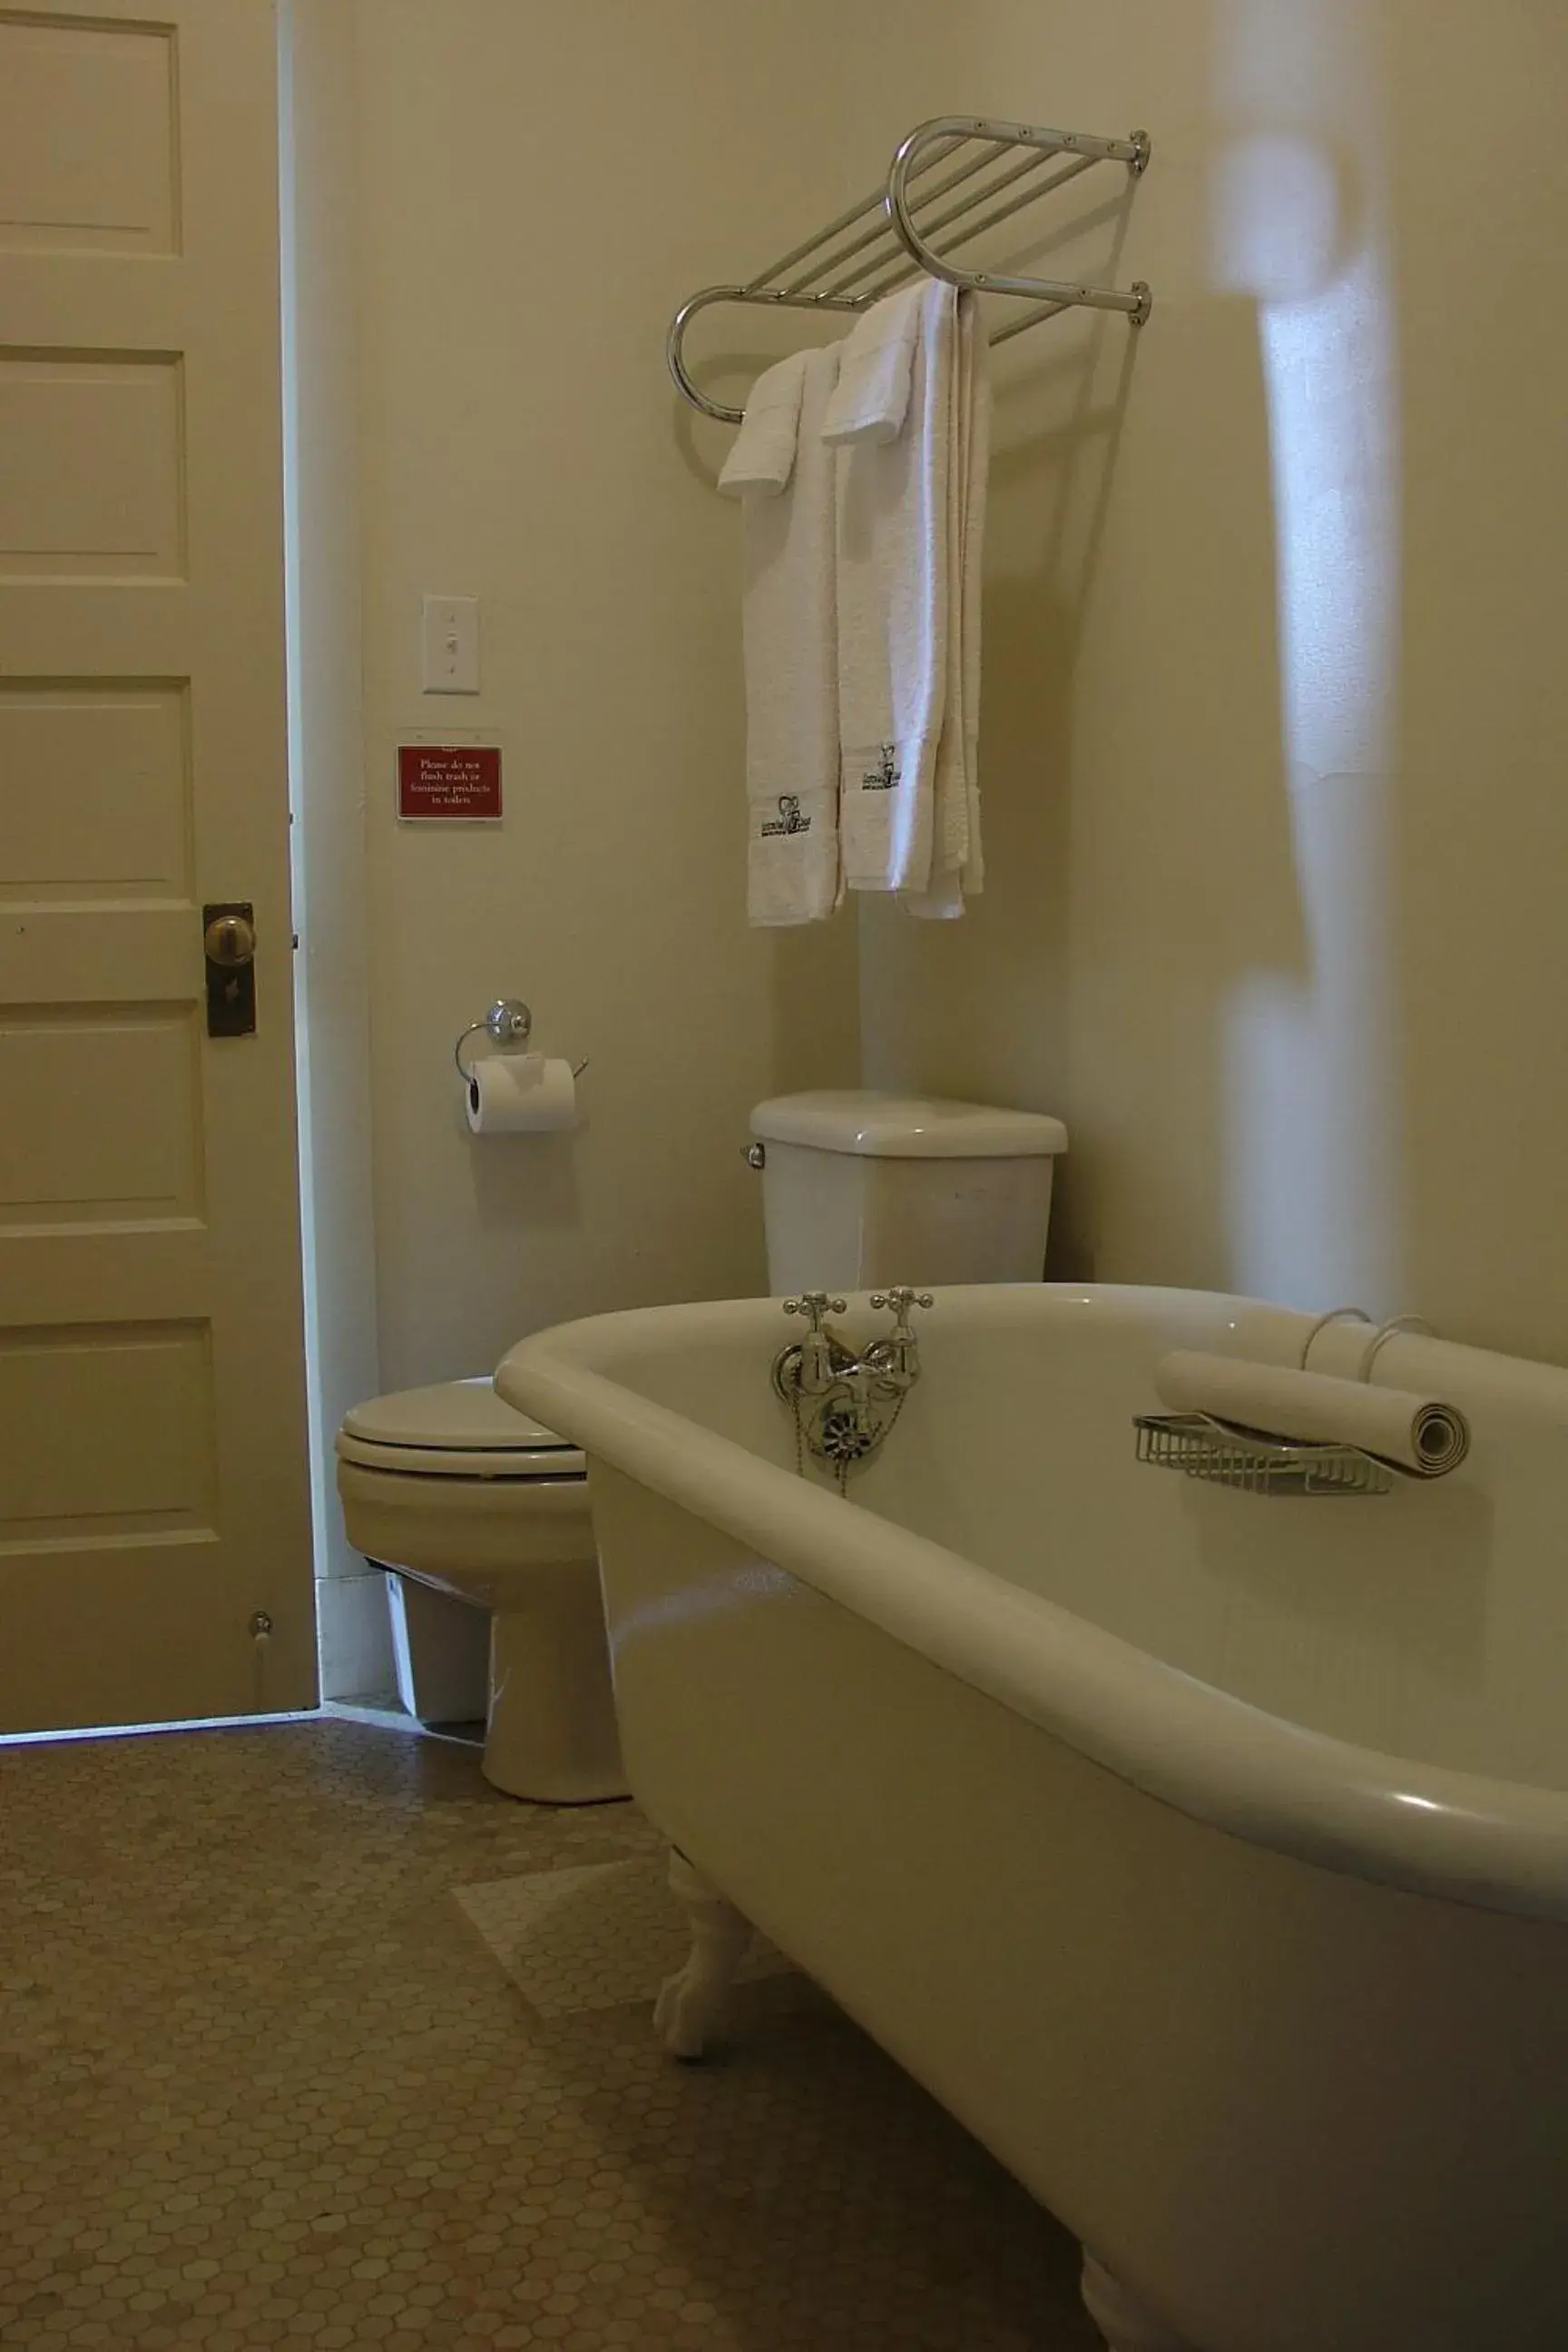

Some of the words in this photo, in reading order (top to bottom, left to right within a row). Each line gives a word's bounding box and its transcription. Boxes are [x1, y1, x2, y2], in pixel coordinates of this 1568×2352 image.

[420, 759, 447, 769] Please
[451, 760, 463, 769] do
[466, 760, 481, 769] not
[421, 770, 443, 780] flush
[446, 771, 467, 780] trash
[410, 782, 448, 792] feminine
[453, 783, 490, 796] products
[432, 796, 441, 804] in
